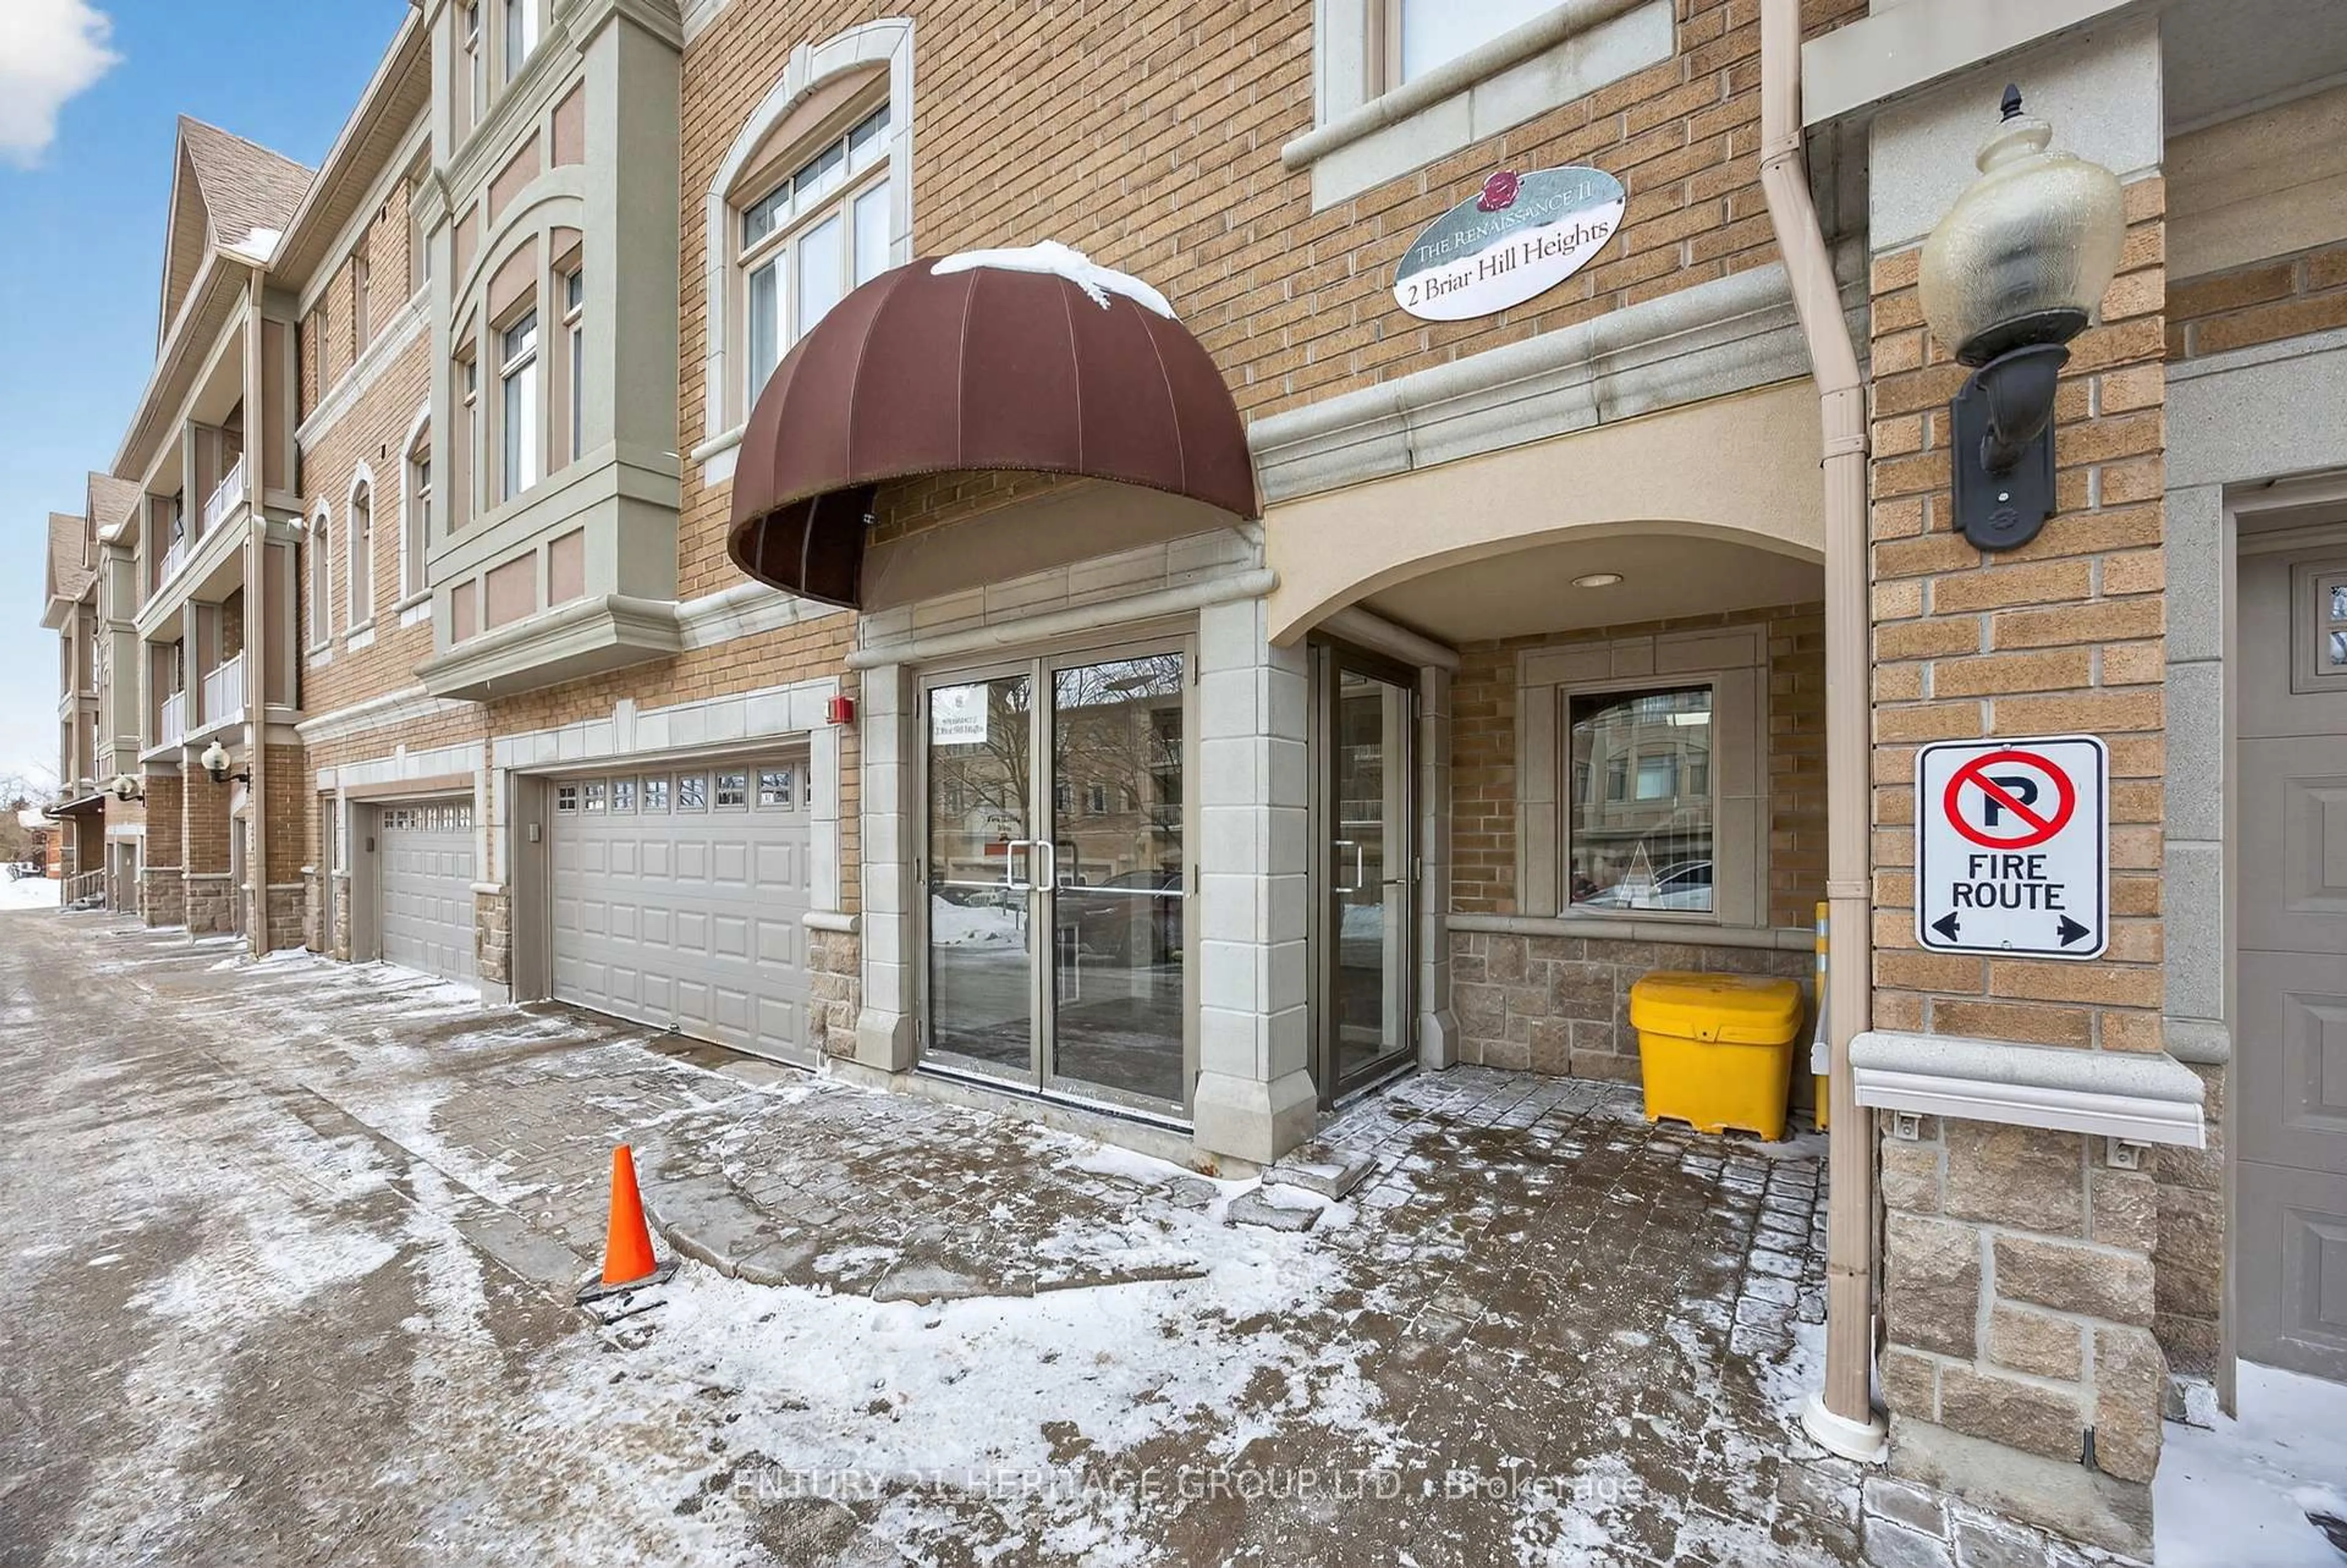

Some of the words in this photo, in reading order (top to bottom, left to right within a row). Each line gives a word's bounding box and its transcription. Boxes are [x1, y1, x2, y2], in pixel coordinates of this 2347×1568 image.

[1416, 239, 1450, 262] THE
[1455, 189, 1574, 248] RENAISSANCE
[1579, 181, 1594, 200] II
[1408, 285, 1419, 306] 2
[1425, 271, 1472, 301] Briar
[1479, 246, 1516, 280] Hill
[1524, 221, 1609, 265] Heights
[1969, 854, 2048, 881] FIRE
[1952, 882, 2066, 910] ROUTE
